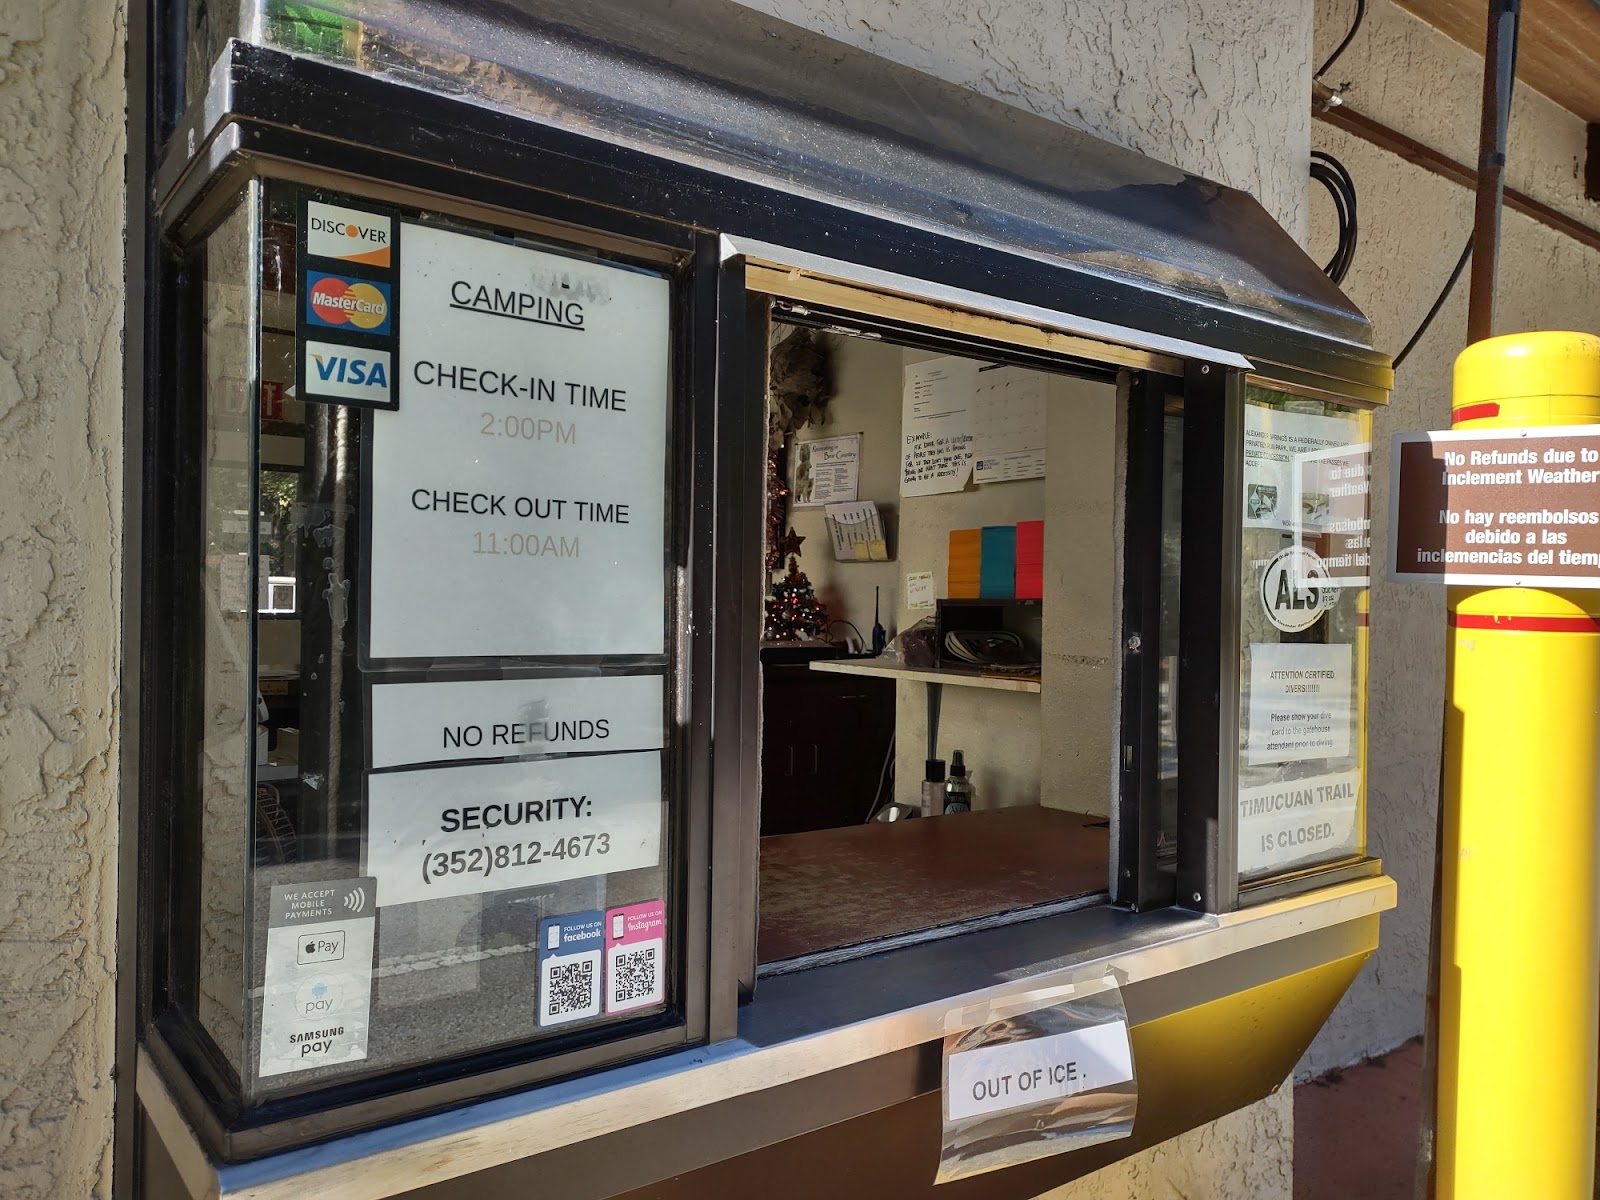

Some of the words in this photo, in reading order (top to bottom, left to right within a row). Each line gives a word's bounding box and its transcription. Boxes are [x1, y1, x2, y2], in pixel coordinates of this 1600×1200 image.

[311, 217, 387, 244] DISCOVER
[312, 291, 386, 316] MasterCard
[451, 281, 584, 326] CAMPING
[310, 353, 387, 388] VISA
[414, 361, 555, 402] CHECK-IN
[565, 382, 627, 412] TIME
[480, 412, 576, 445] 2:00PM
[1444, 451, 1466, 466] No
[1470, 449, 1538, 466] Refunds
[1543, 448, 1575, 464] due
[1580, 447, 1599, 463] to
[1442, 470, 1523, 486] Inclement
[1527, 468, 1599, 484] Weather
[411, 489, 506, 516] CHECK
[514, 497, 567, 520] OUT
[574, 501, 630, 524] TIME
[1439, 509, 1460, 524] No
[1465, 510, 1495, 527] hay
[1499, 509, 1599, 525] reembolsos
[473, 532, 580, 558] 11:00AM
[1465, 529, 1520, 545] debido
[1525, 533, 1536, 544] a
[1542, 530, 1568, 545] las
[1417, 548, 1523, 564] inclemencias
[1527, 549, 1554, 564] del
[1558, 549, 1600, 569] tiem
[1274, 569, 1320, 610] ALS
[1270, 671, 1304, 680] ATTENTION
[1304, 670, 1335, 679] CERTIFIED
[1270, 713, 1290, 722] Please
[1291, 713, 1306, 721] show
[1306, 713, 1320, 722] your
[1320, 711, 1332, 720] dive
[442, 725, 483, 749] NO
[492, 719, 610, 746] REFUNDS
[1271, 726, 1285, 736] card
[1285, 727, 1292, 735] to
[1292, 726, 1302, 735] the
[1302, 725, 1331, 736] gatehouse
[1266, 741, 1294, 751] attendant
[1294, 740, 1309, 750] prior
[1309, 739, 1316, 747] to
[1240, 788, 1314, 818] TIMUCUAN
[1316, 782, 1354, 803] TRAIL
[440, 795, 593, 833] SECURITY:
[1261, 835, 1274, 853] IS
[1277, 822, 1335, 848] CLOSED.
[422, 832, 611, 885] (352)812-4673
[284, 892, 299, 901] WE
[301, 889, 336, 900] ACCEPT
[285, 908, 333, 920] PAYMENTS
[291, 900, 325, 910] MOBILE
[627, 919, 663, 932] Instagram
[628, 913, 647, 922] FOLLOW
[563, 924, 586, 932] FOLLOW
[563, 928, 601, 943] facebook
[318, 940, 339, 955] Pay
[305, 997, 334, 1014] pay
[289, 1026, 345, 1044] SAMSUNG
[301, 1039, 333, 1058] pay
[972, 1074, 1012, 1102] OUT
[1018, 1069, 1043, 1092] OF
